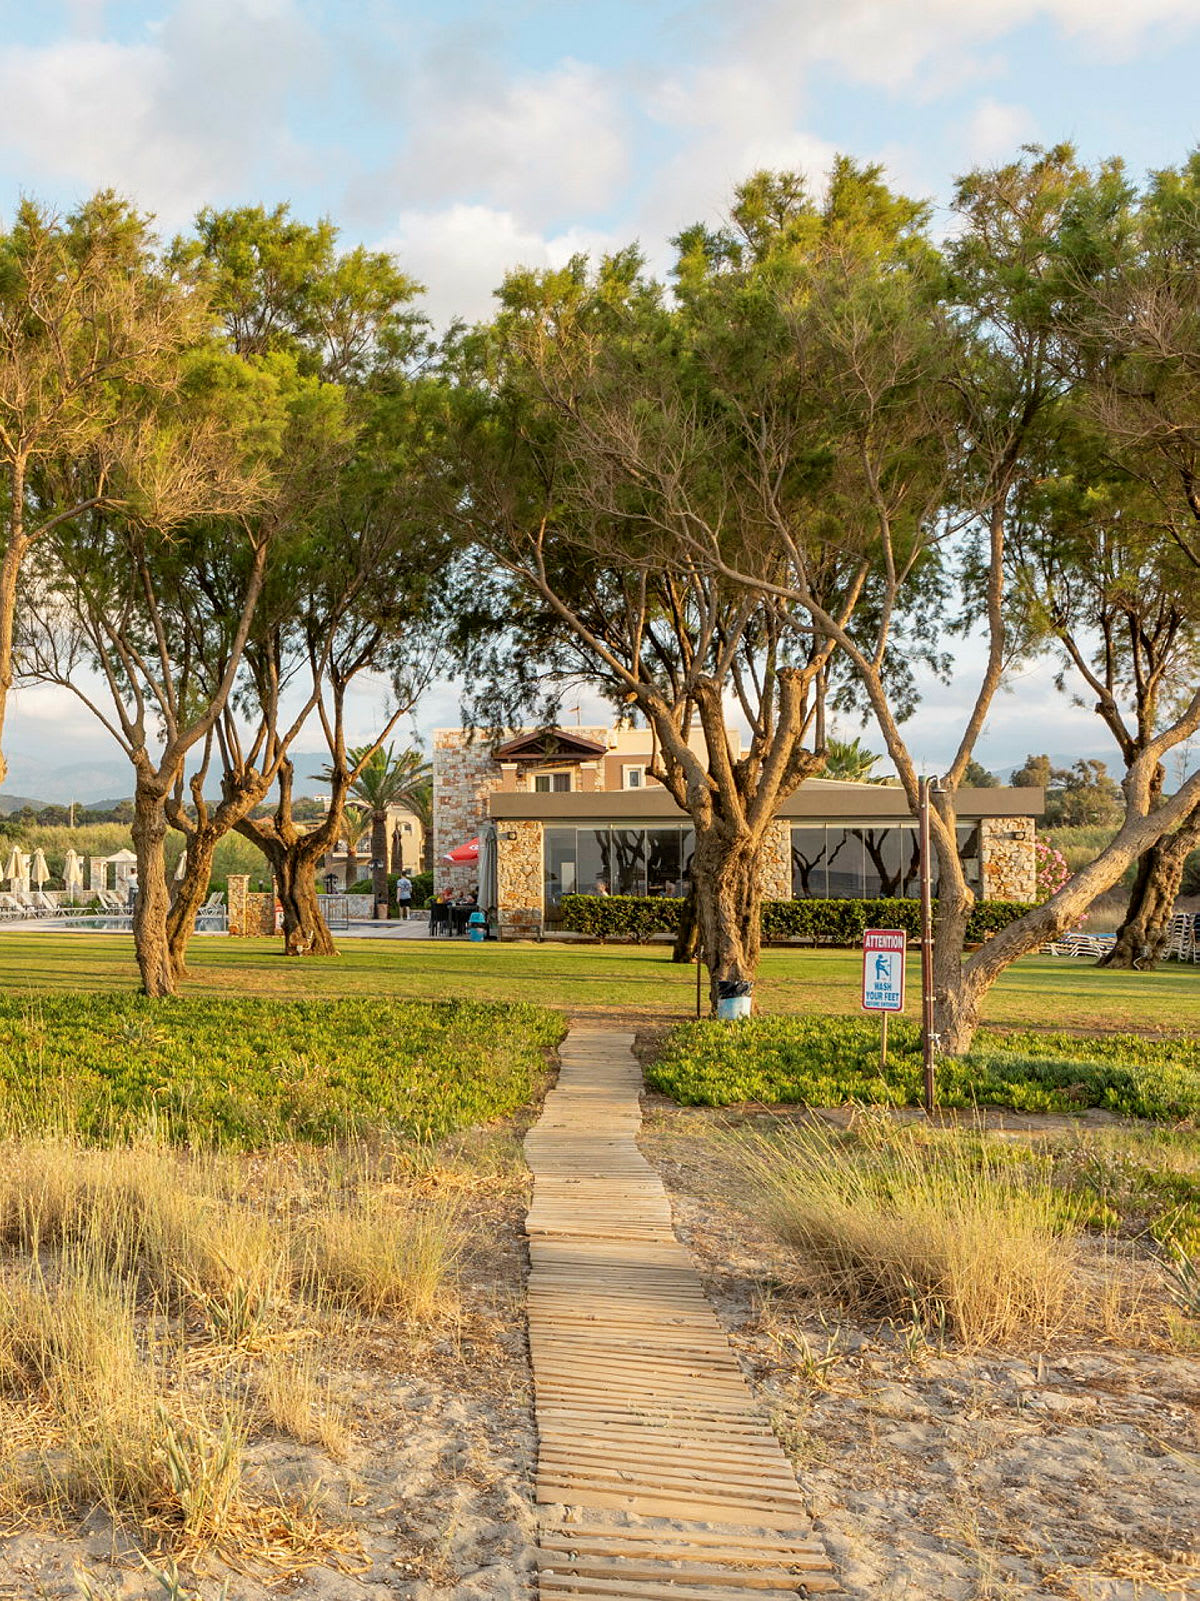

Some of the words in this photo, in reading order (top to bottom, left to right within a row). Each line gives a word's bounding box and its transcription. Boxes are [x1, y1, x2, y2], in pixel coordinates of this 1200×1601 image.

[866, 935, 902, 948] ATTENTION
[875, 982, 891, 991] WASH
[866, 991, 883, 1000] YOUR
[884, 993, 899, 1002] FEET
